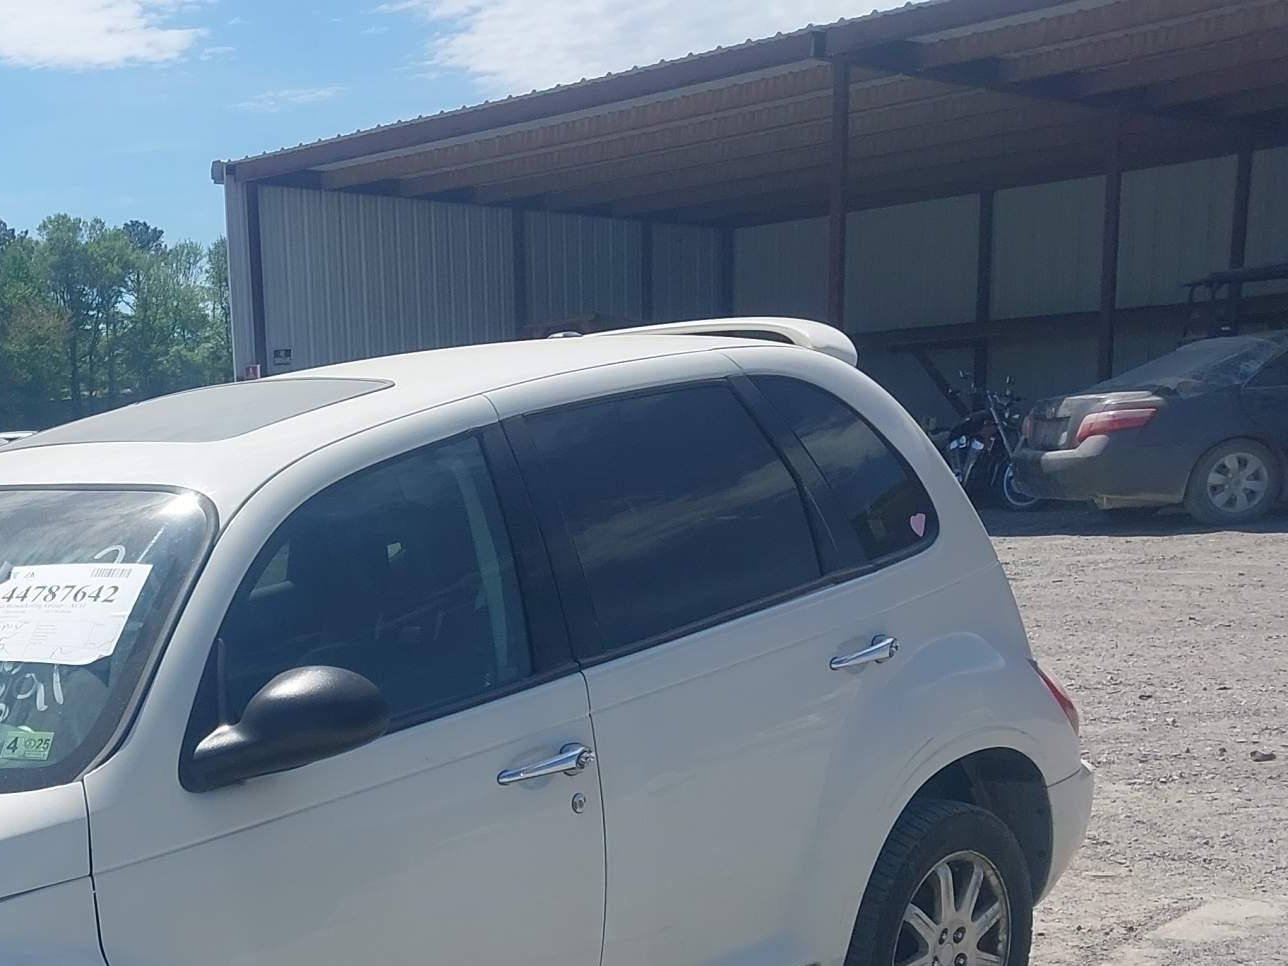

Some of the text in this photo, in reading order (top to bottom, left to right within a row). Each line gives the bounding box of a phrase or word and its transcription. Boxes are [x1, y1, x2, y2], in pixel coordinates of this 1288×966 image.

[1, 584, 120, 605] 44787642
[6, 736, 51, 753] 4 25
